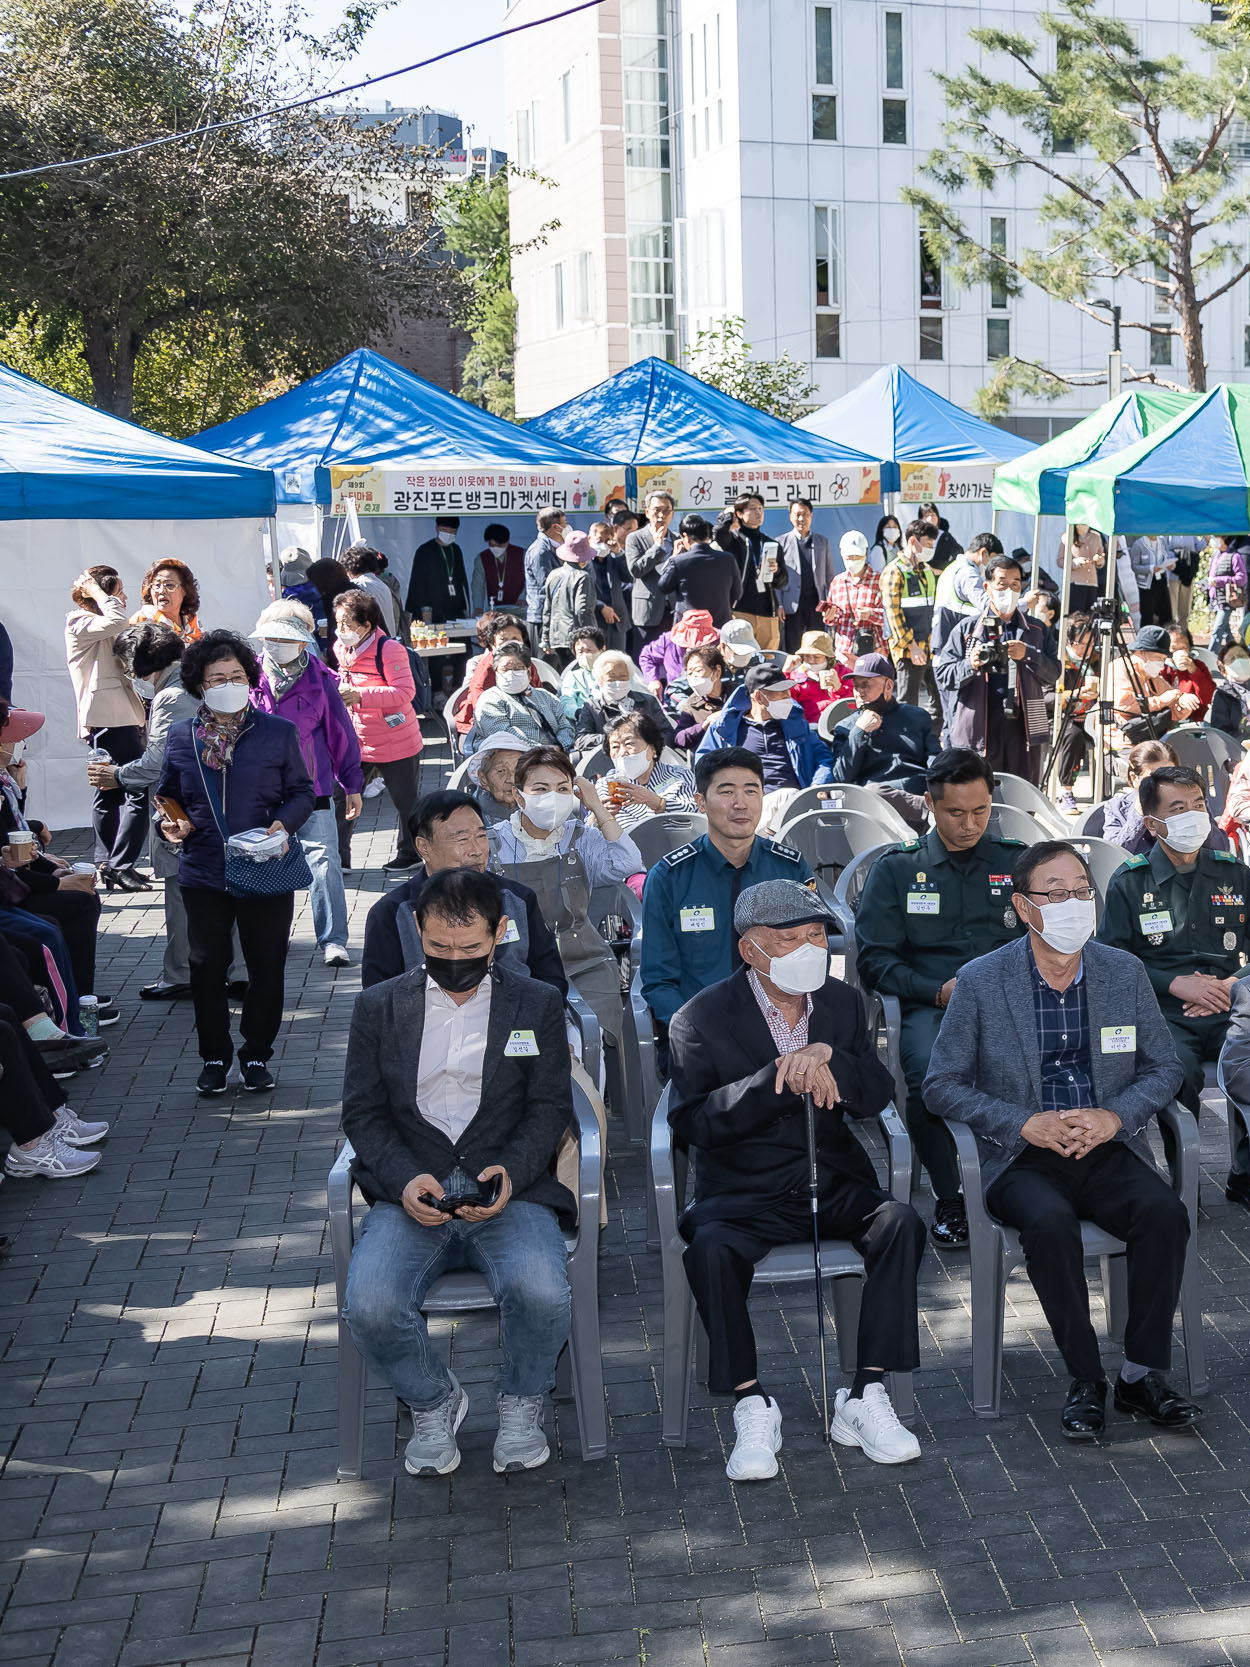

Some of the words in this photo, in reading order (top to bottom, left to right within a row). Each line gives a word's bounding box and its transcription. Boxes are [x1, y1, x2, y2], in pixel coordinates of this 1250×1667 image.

[772, 470, 815, 480] 적어드립니다
[347, 481, 366, 489] 제9회
[406, 476, 425, 488] 작은
[428, 476, 455, 488] 정성이
[458, 476, 495, 487] 이웃에게
[497, 476, 506, 487] 큰
[509, 476, 527, 487] 힘이
[530, 476, 556, 487] 됩니다
[948, 483, 993, 499] 찾아가는
[393, 490, 567, 512] 광진푸드뱅크마켓센터
[363, 503, 381, 513] 축제
